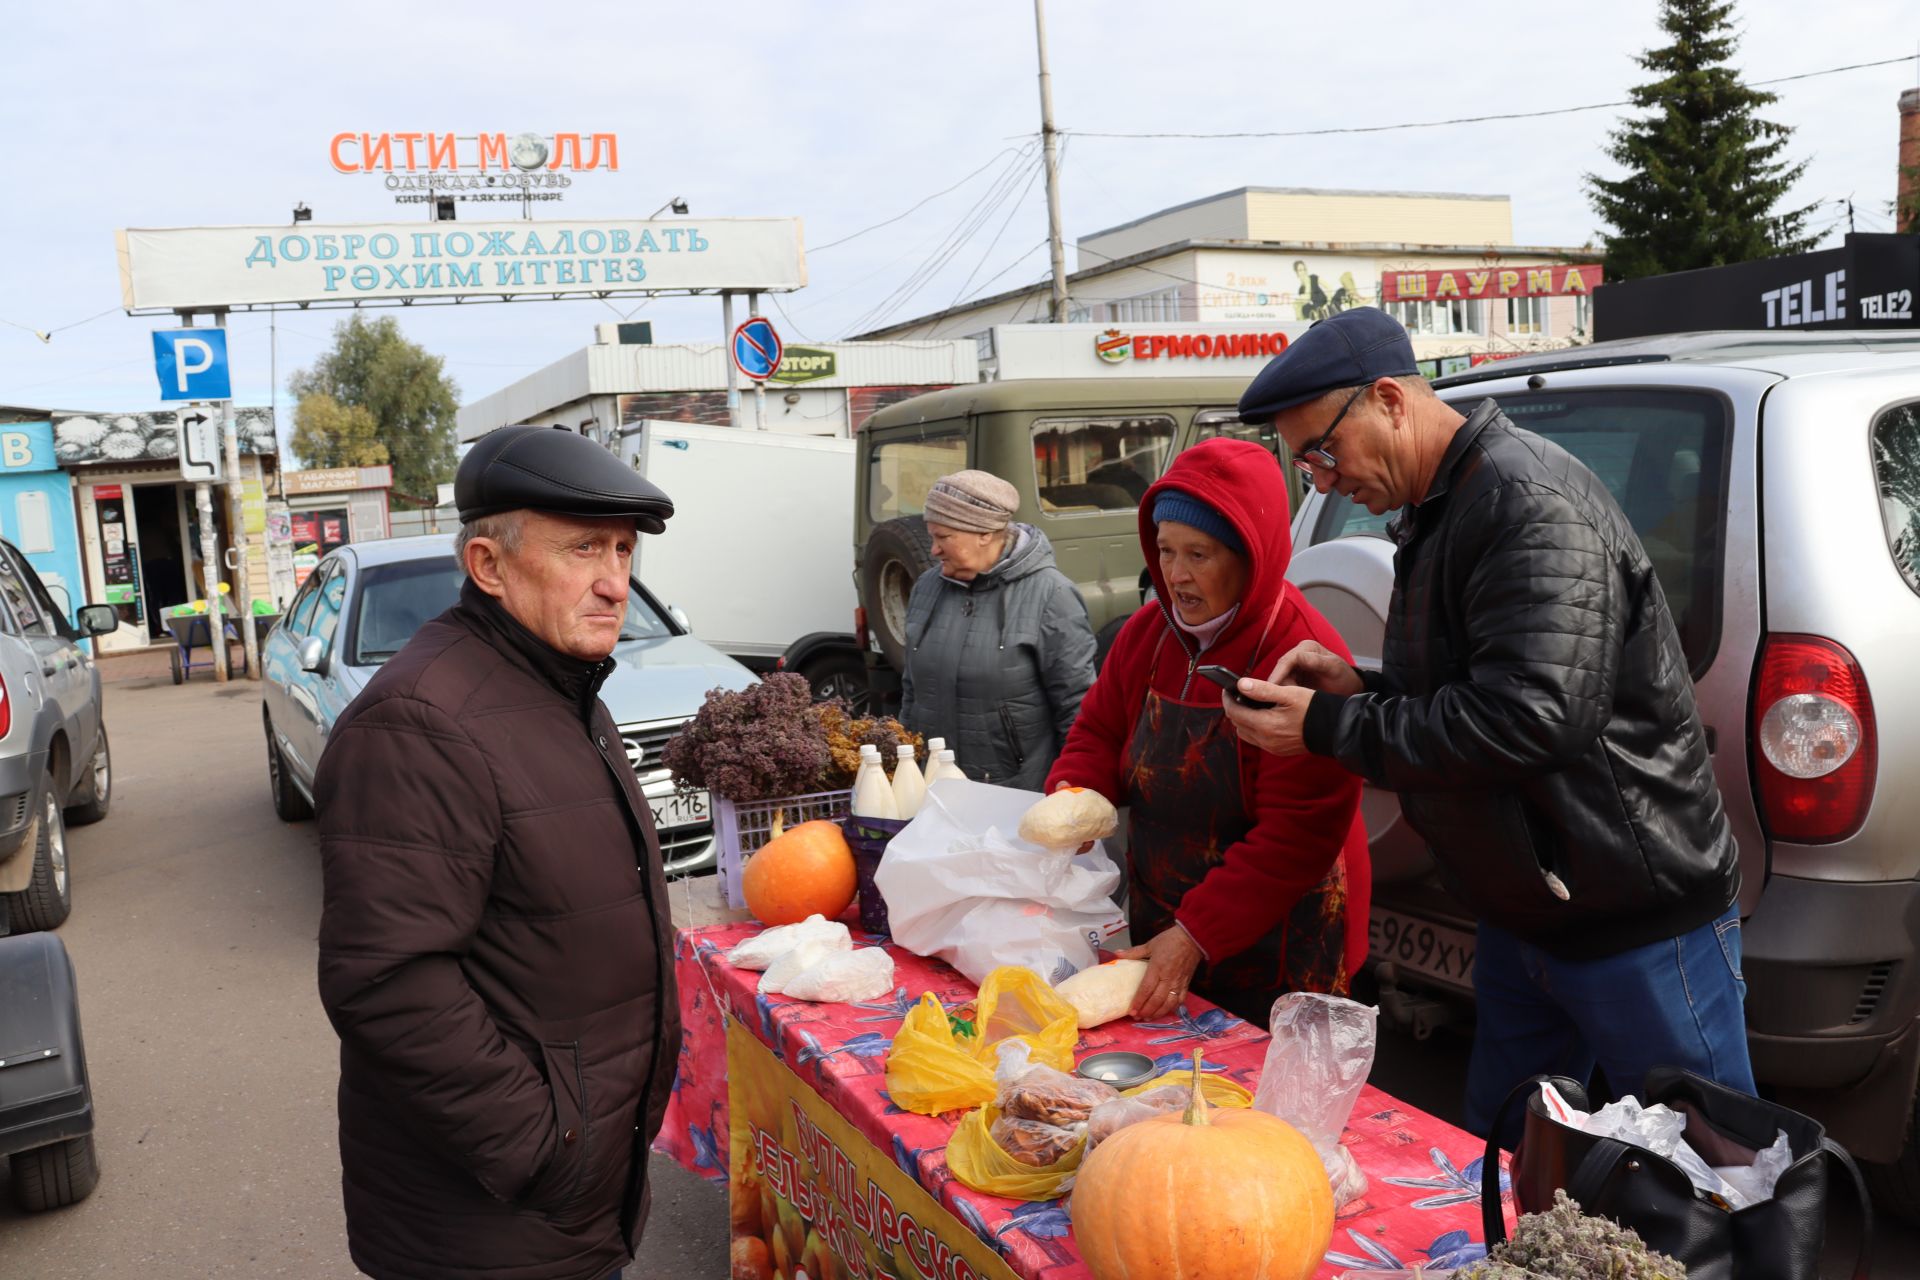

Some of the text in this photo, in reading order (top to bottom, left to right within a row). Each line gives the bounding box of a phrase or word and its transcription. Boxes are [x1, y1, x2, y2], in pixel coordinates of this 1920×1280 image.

[329, 131, 458, 174] СИТИ
[384, 173, 572, 191] ОДЕЖДА ОБУВЬ
[245, 228, 710, 269] ДОБРО ПОЖАЛОВАТЬ
[322, 257, 648, 291] РӘХИМ ИТЕГЕЗ
[1396, 268, 1586, 298] ШАУРМА
[1761, 269, 1847, 328] TELE
[1860, 289, 1913, 319] TELE2
[1132, 332, 1290, 360] ЕРМОЛИНО
[174, 338, 214, 393] P
[780, 356, 831, 371] ЗТОРГ
[789, 1096, 992, 1280] БУЛДЫРСК
